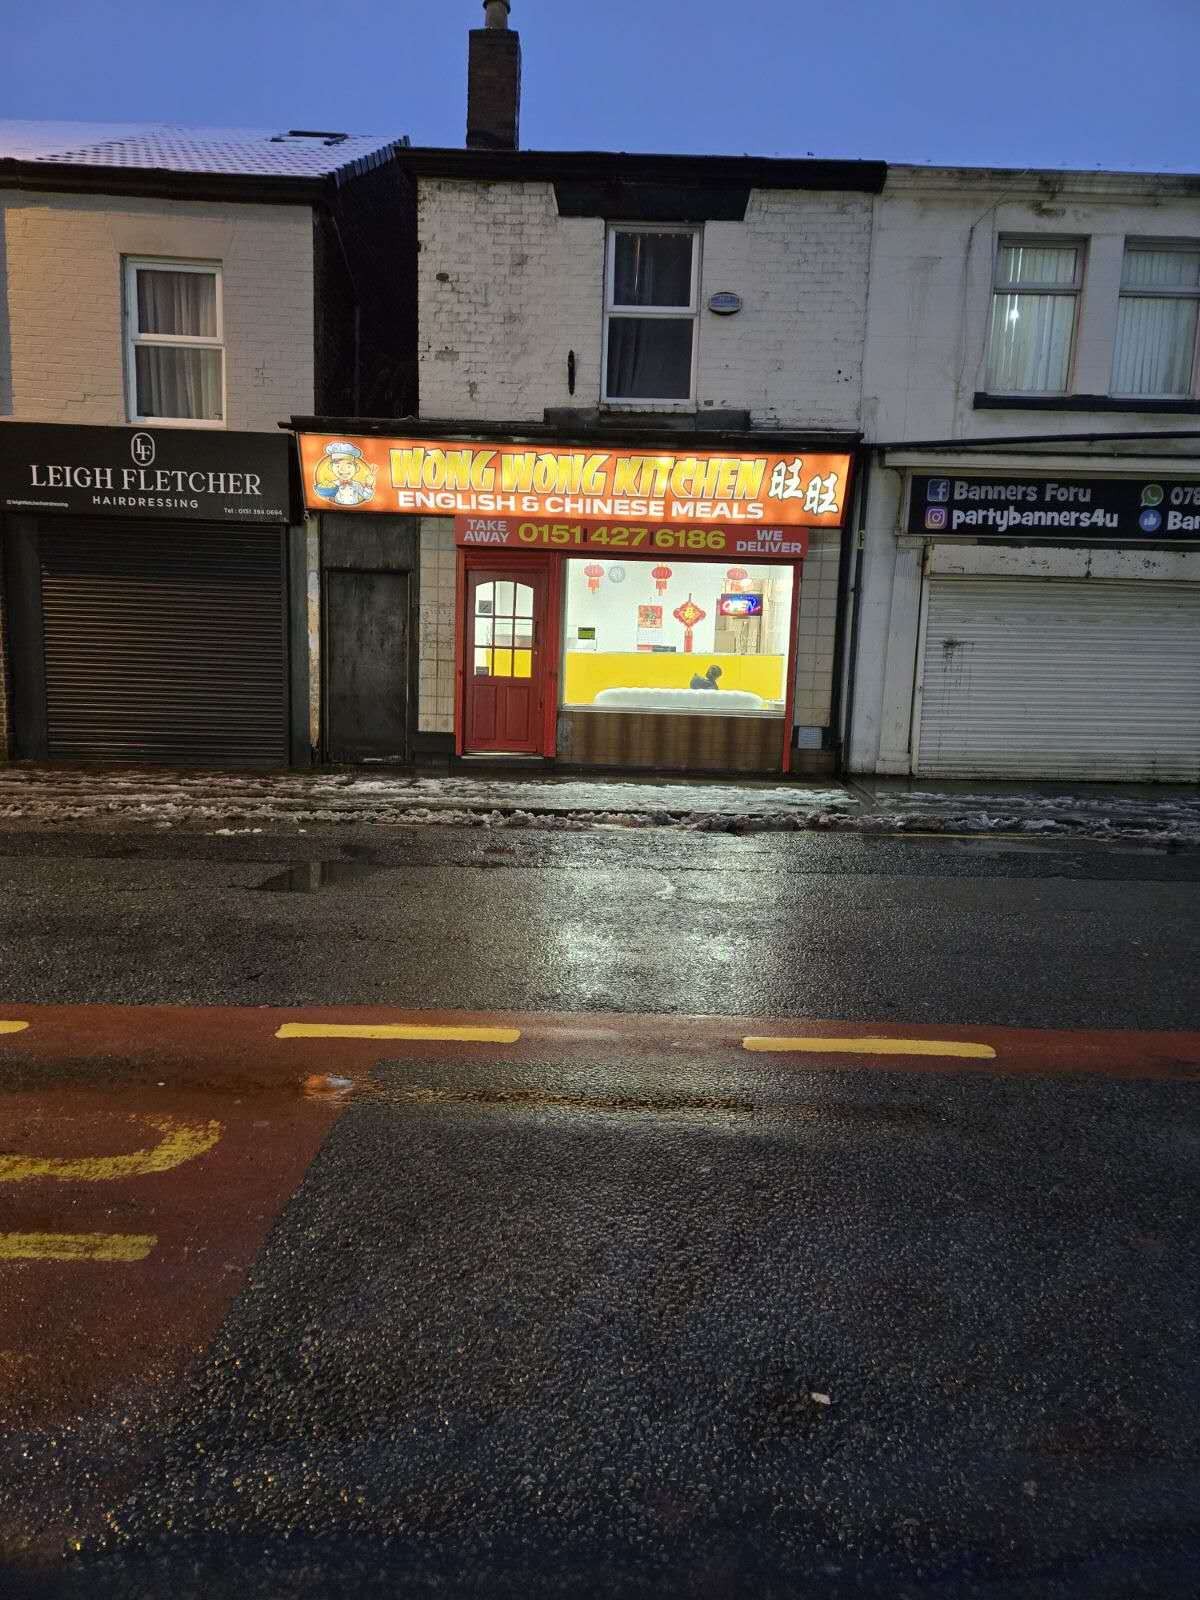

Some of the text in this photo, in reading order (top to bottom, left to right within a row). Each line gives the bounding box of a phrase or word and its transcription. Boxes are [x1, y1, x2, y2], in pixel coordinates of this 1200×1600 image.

[30, 464, 262, 496] LEIGH FLETCHER
[389, 447, 767, 501] WONG WONG KITCHEN
[953, 481, 1091, 503] Banners Foru
[92, 495, 199, 509] HAIRDRESSING
[398, 491, 764, 520] ENGLISH & CHINESE MEALS
[467, 519, 507, 532] TAKE
[952, 506, 1119, 532] partybanners4u
[463, 531, 511, 544] AWAY
[518, 523, 727, 550] 0151 427 6186
[756, 530, 784, 542] WE
[736, 540, 803, 554] DELIVER
[722, 597, 761, 614] OPEN
